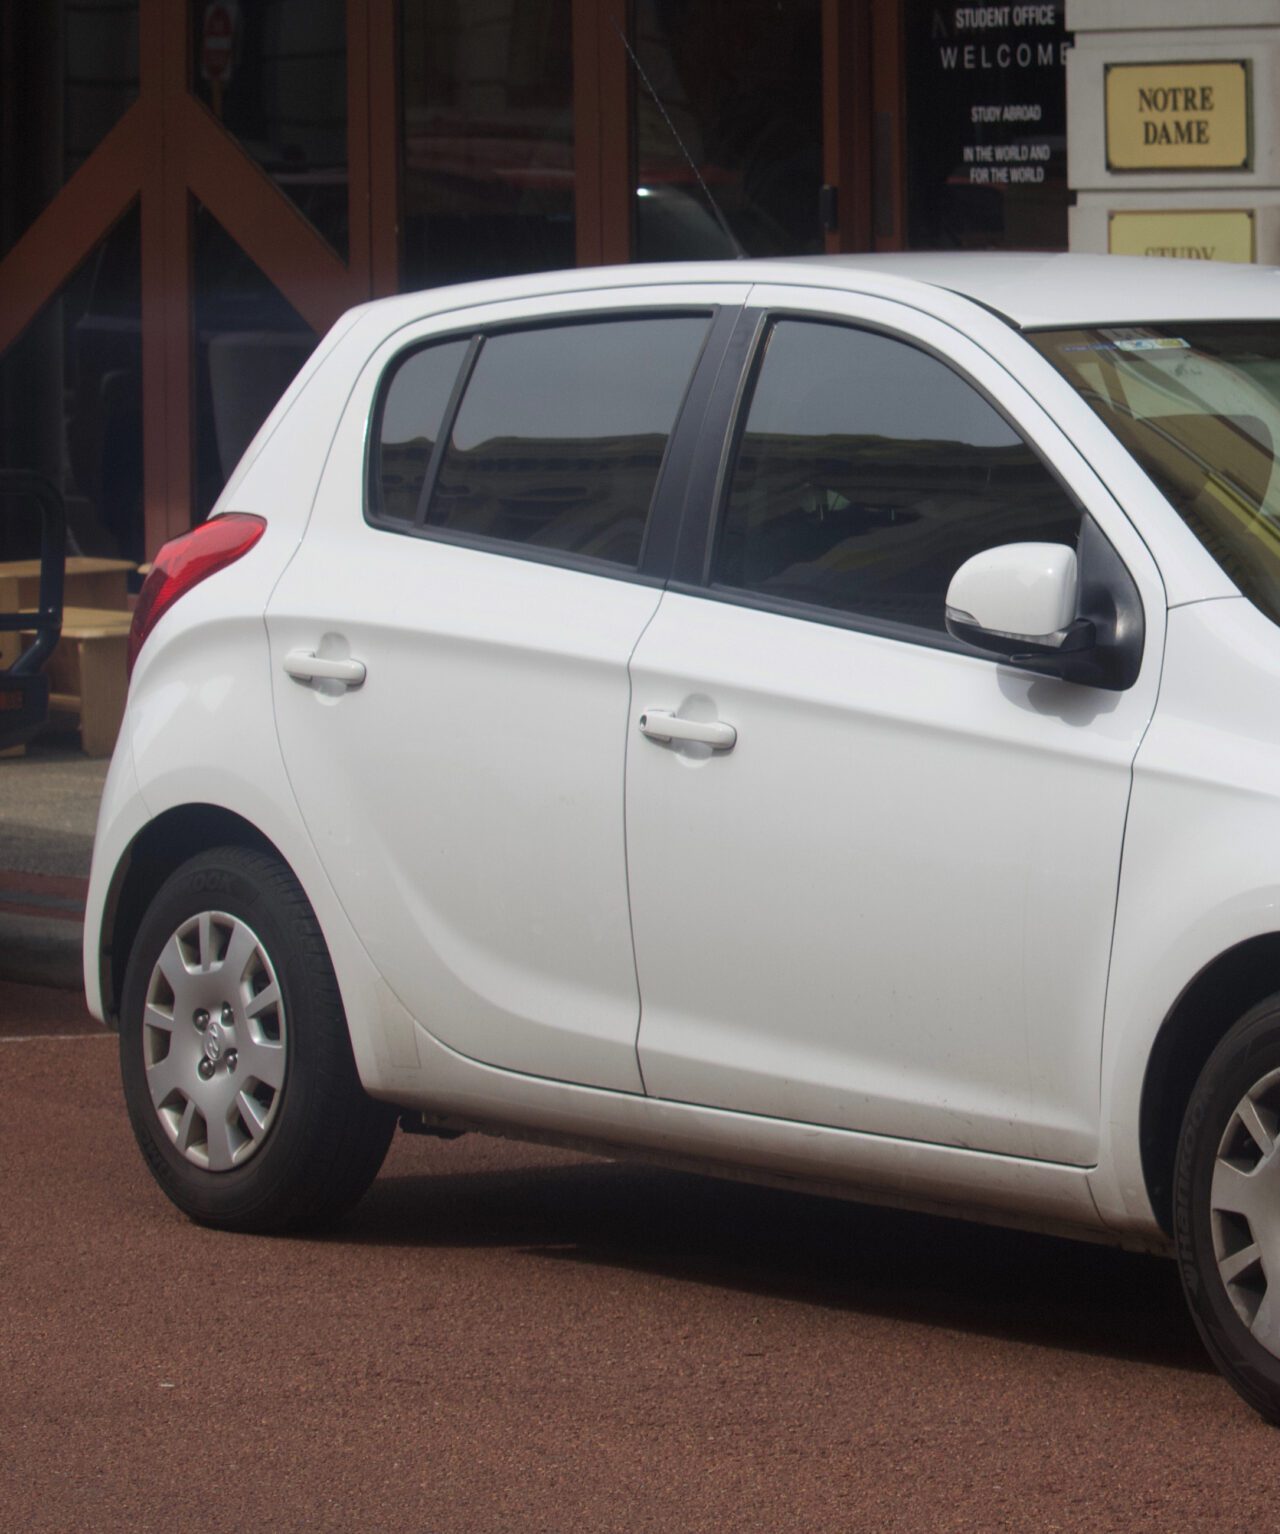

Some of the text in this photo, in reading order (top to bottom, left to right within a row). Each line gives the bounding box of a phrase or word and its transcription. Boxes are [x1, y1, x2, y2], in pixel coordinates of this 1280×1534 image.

[955, 6, 1010, 29] STUDENT
[1012, 5, 1056, 26] OFFICE
[940, 41, 1071, 69] WELCOME
[1138, 86, 1214, 112] NOTRE
[971, 103, 1042, 122] STUDY ABROAD
[1143, 120, 1209, 145] DAME
[963, 143, 1050, 162] IN THE WORLD AND
[969, 166, 1044, 184] FOR THE WORLD
